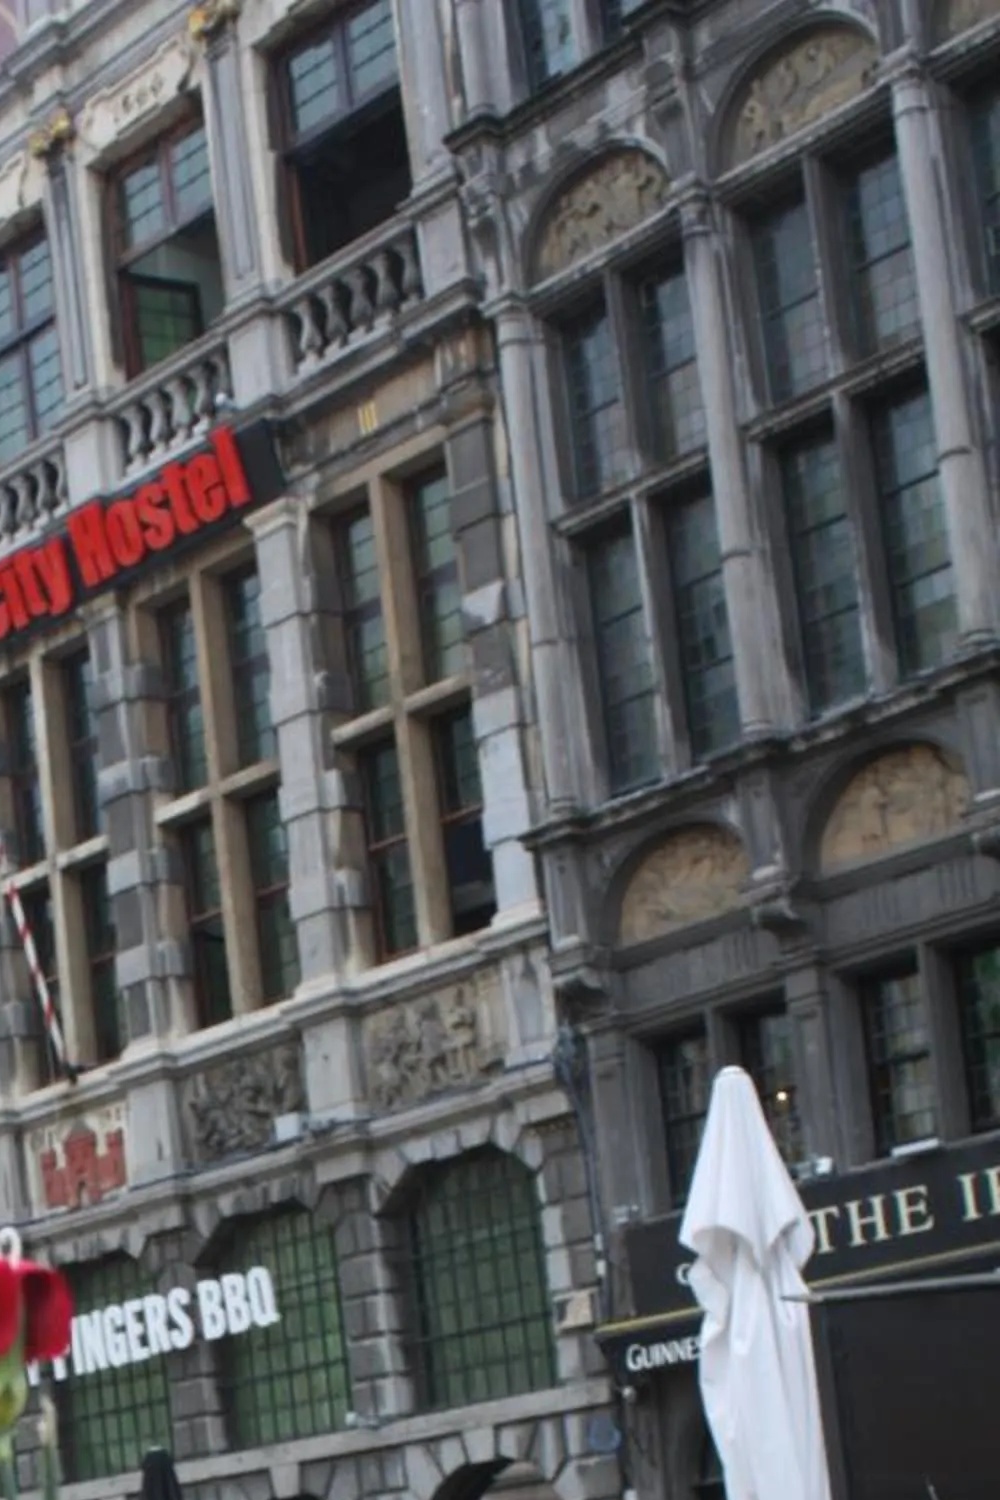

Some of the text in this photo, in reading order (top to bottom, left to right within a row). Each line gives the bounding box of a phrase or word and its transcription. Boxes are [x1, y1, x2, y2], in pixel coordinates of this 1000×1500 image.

[67, 425, 253, 588] Hostel
[807, 1184, 935, 1255] THE
[52, 1266, 280, 1380] INGERS BBQ
[625, 1335, 702, 1372] GUINNE
